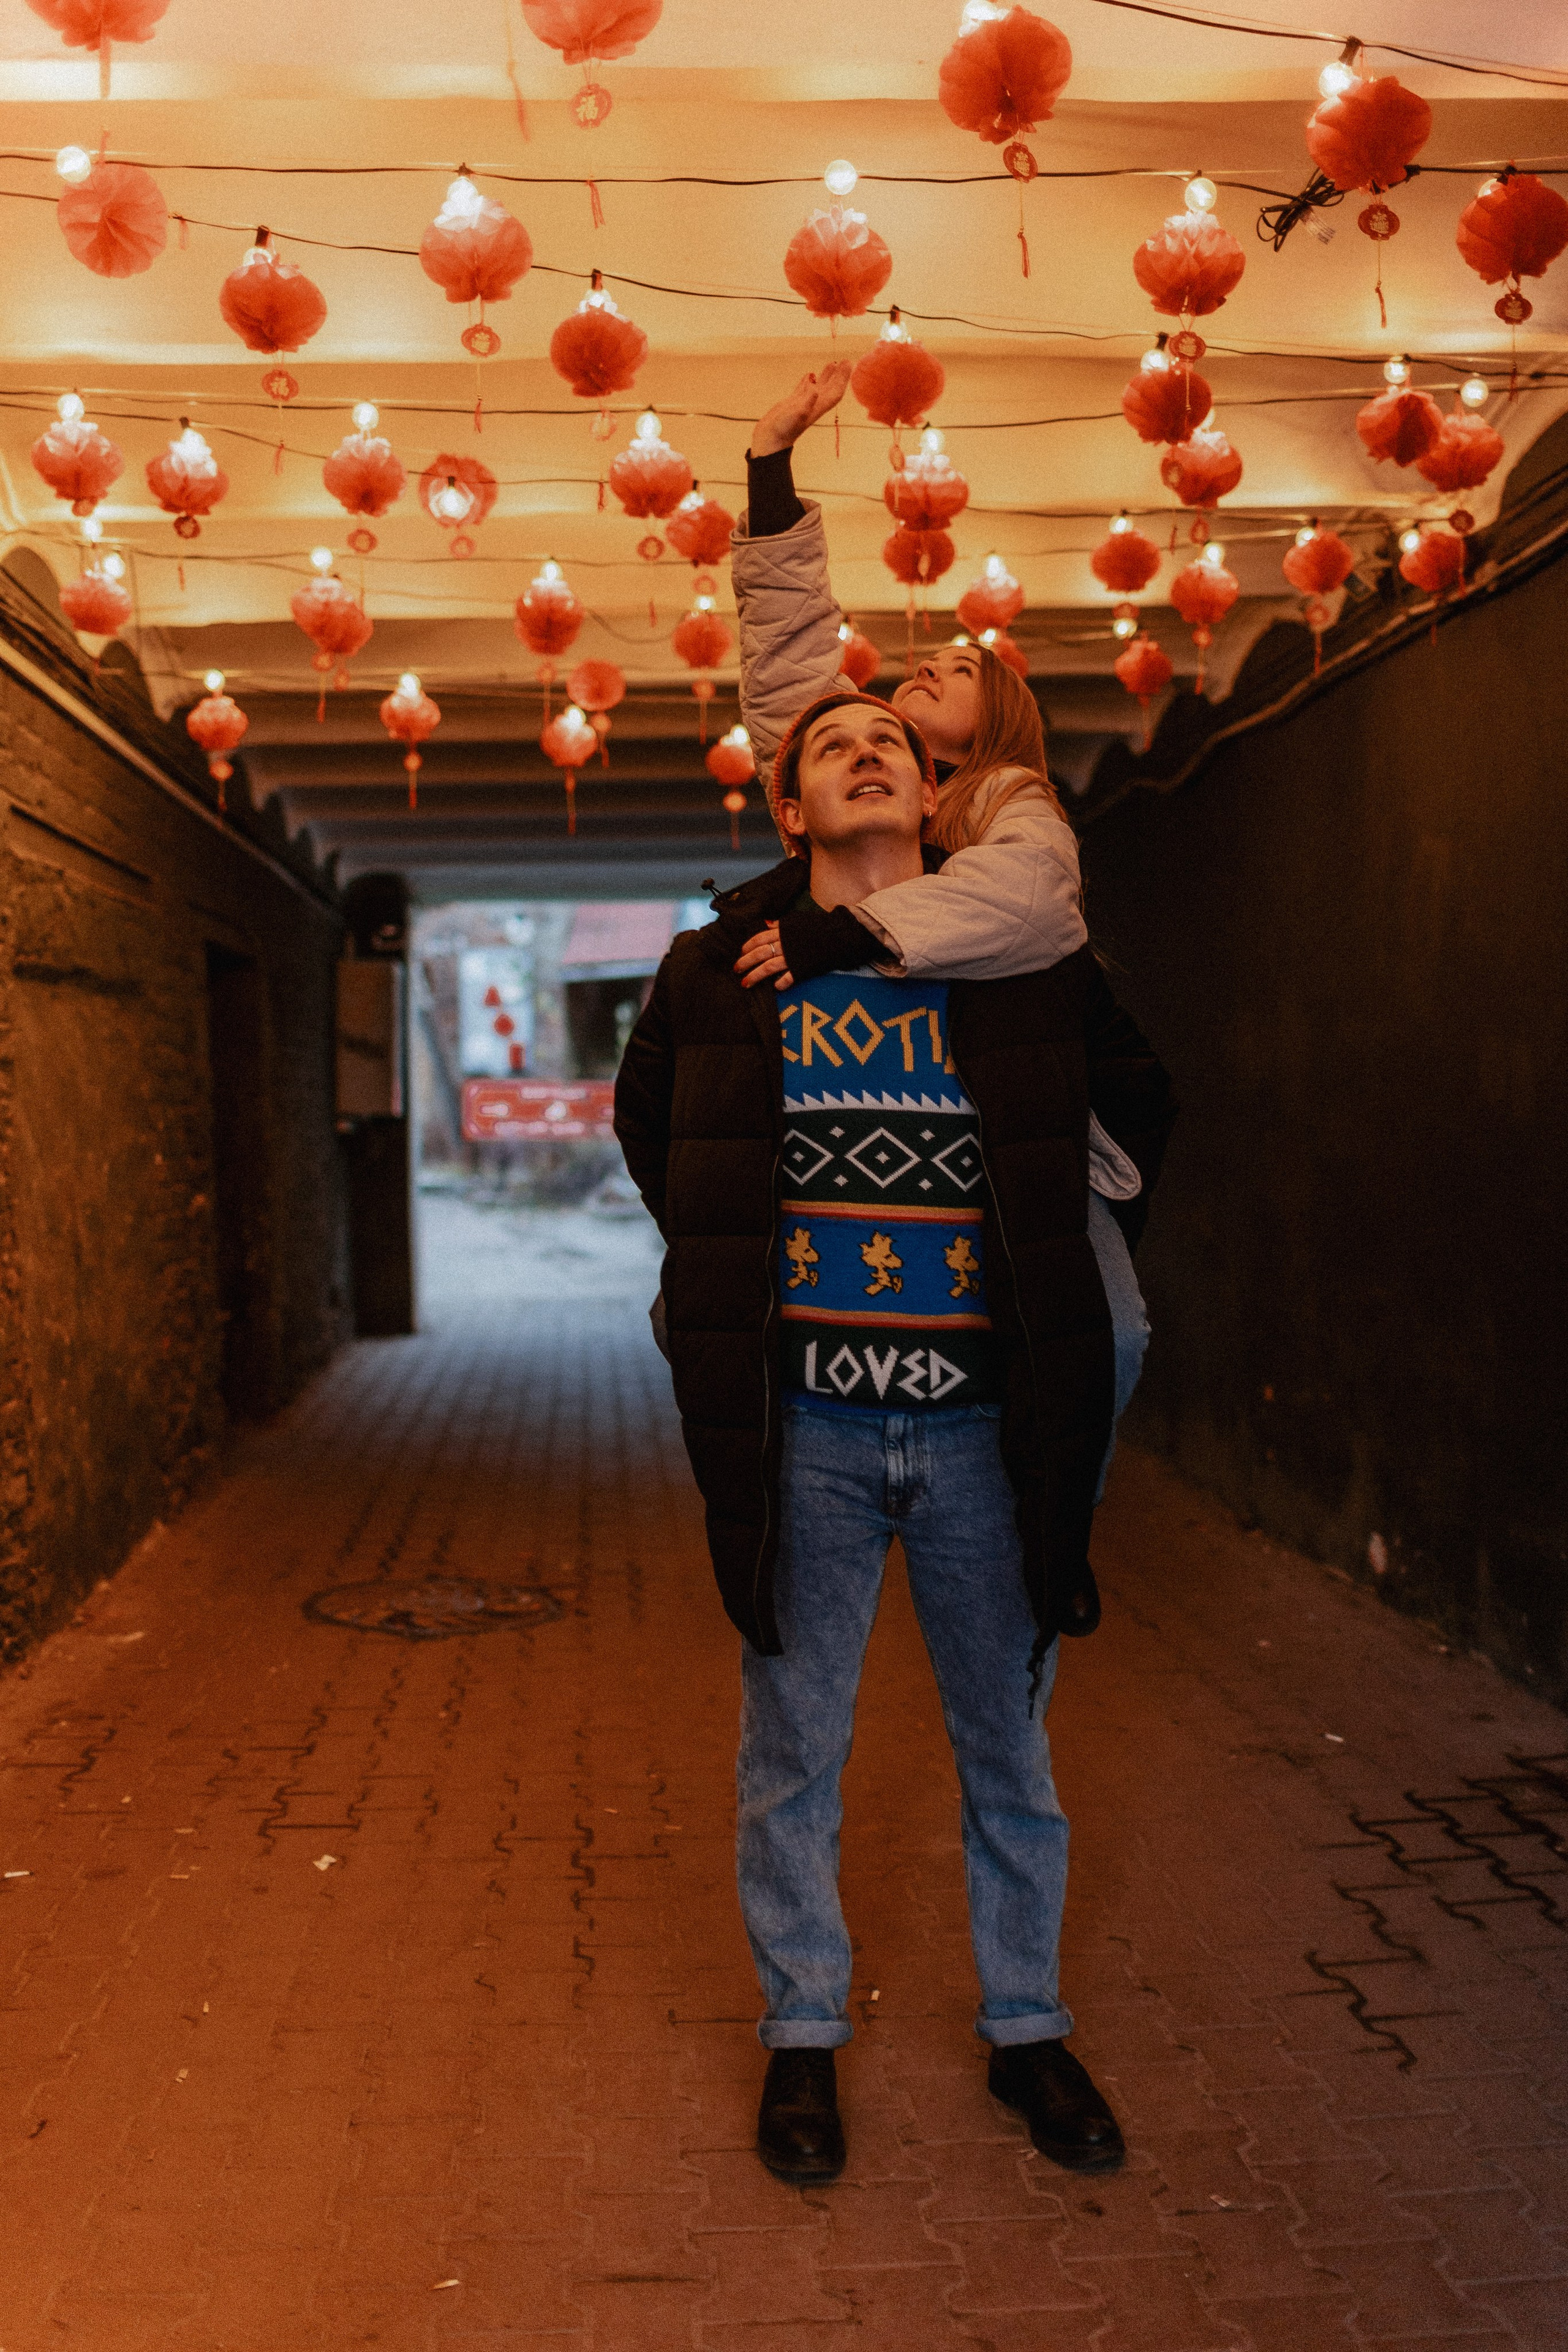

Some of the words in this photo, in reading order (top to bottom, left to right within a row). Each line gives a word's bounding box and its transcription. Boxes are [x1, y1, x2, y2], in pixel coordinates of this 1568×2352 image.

[575, 94, 599, 123] 福
[779, 998, 956, 1074] EROTI
[805, 1341, 968, 1400] LOVED
